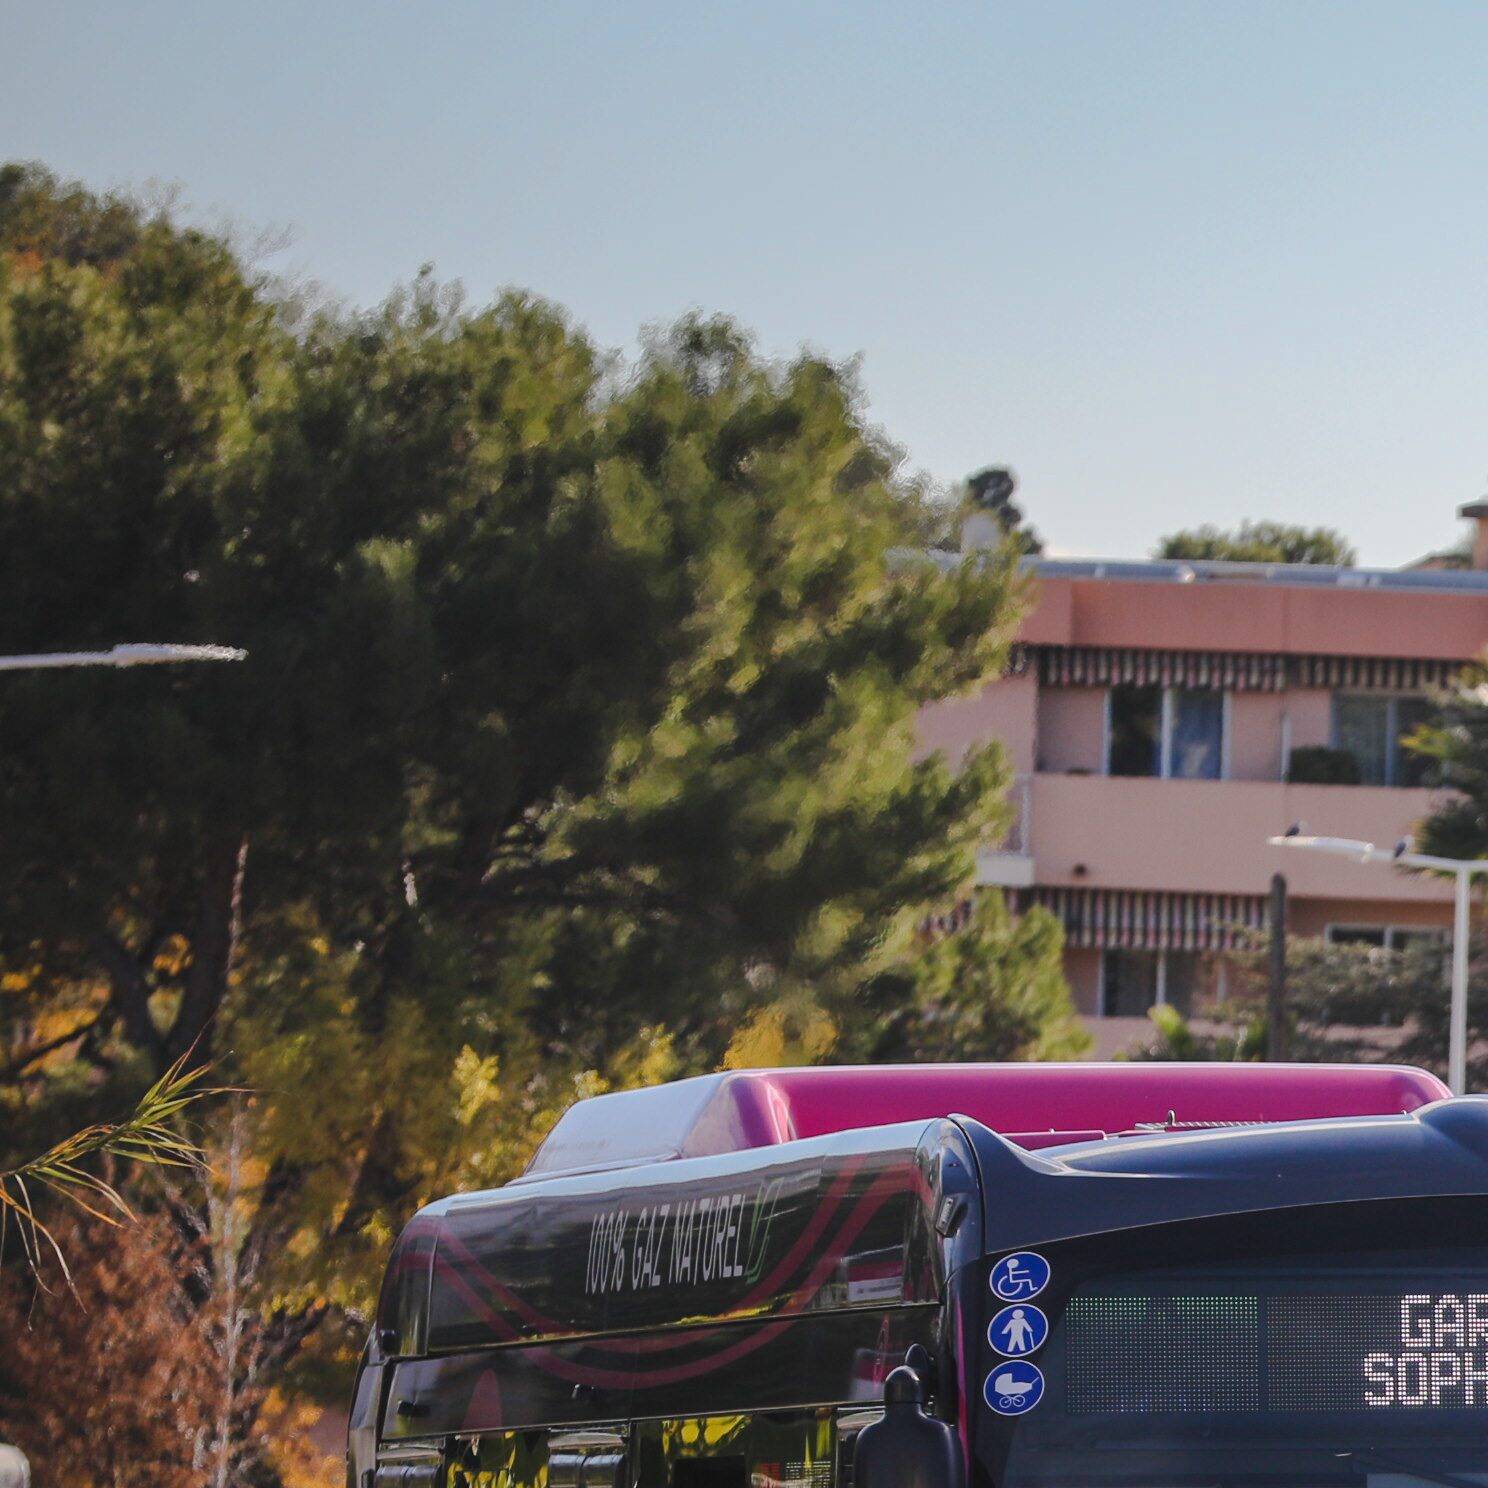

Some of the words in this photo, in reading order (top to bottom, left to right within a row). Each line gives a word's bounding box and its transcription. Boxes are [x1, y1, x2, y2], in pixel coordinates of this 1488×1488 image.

[585, 1210, 630, 1295] 100%
[632, 1203, 670, 1291] GAZ
[668, 1193, 746, 1286] NATUREL
